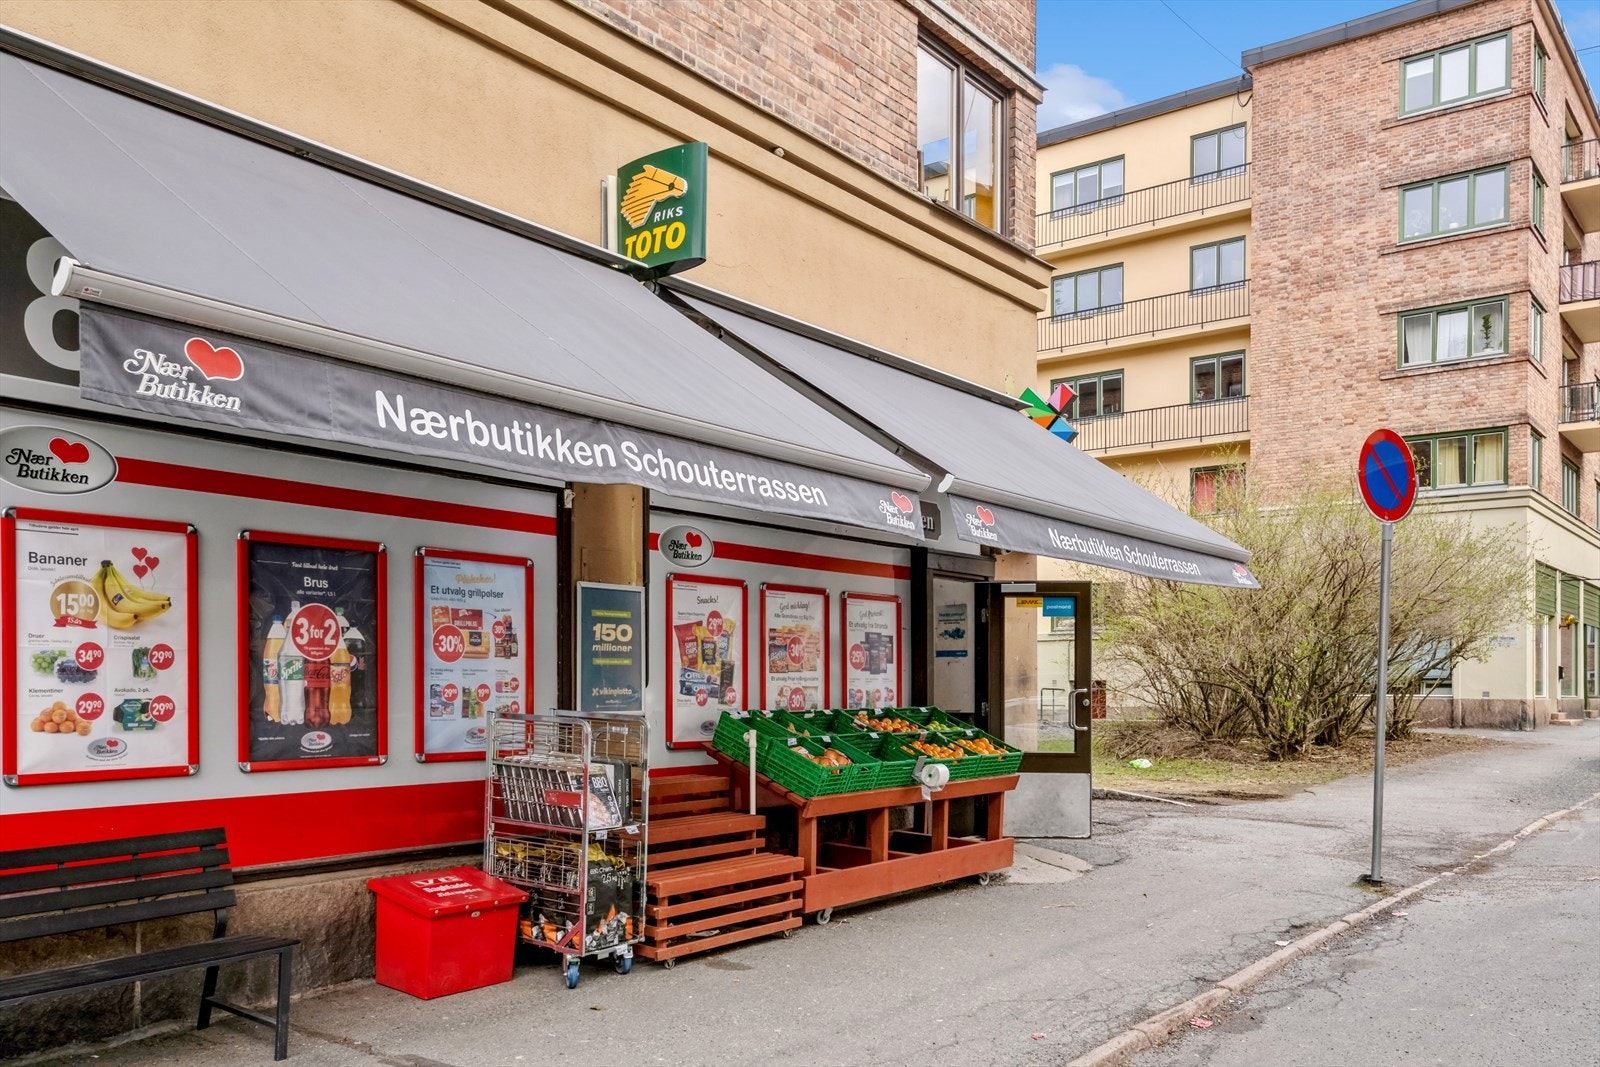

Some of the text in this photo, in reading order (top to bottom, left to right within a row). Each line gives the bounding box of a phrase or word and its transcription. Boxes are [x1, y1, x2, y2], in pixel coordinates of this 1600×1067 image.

[654, 206, 684, 223] RIKS
[625, 221, 686, 259] TOTO
[124, 348, 195, 380] Nær
[136, 374, 242, 412] Butikken
[375, 390, 829, 506] Nærbutikken Schouterrassen
[6, 448, 54, 466] Nær
[16, 464, 89, 485] Butikken
[879, 500, 898, 514] Nær
[886, 512, 915, 529] Butikken
[966, 513, 982, 526] Nær
[970, 525, 998, 541] Butikken
[668, 540, 688, 551] Nær
[1048, 527, 1201, 576] Nærbutikken Schouterrassen
[29, 552, 87, 566] Bananer
[673, 549, 702, 561] Butikken
[304, 577, 328, 588] Brus
[431, 586, 504, 599] Et utvalg grillpølser
[697, 595, 718, 604] Snacks!
[295, 617, 336, 645] 3 for 2
[592, 623, 633, 642] 150
[435, 635, 463, 653] -30%
[592, 643, 632, 652] millioner
[78, 649, 102, 663] 3490
[152, 651, 173, 663] 2990
[281, 660, 303, 680] Sprite
[599, 687, 632, 697] vikinglotto
[79, 700, 102, 714] 2990
[152, 702, 173, 716] 2990
